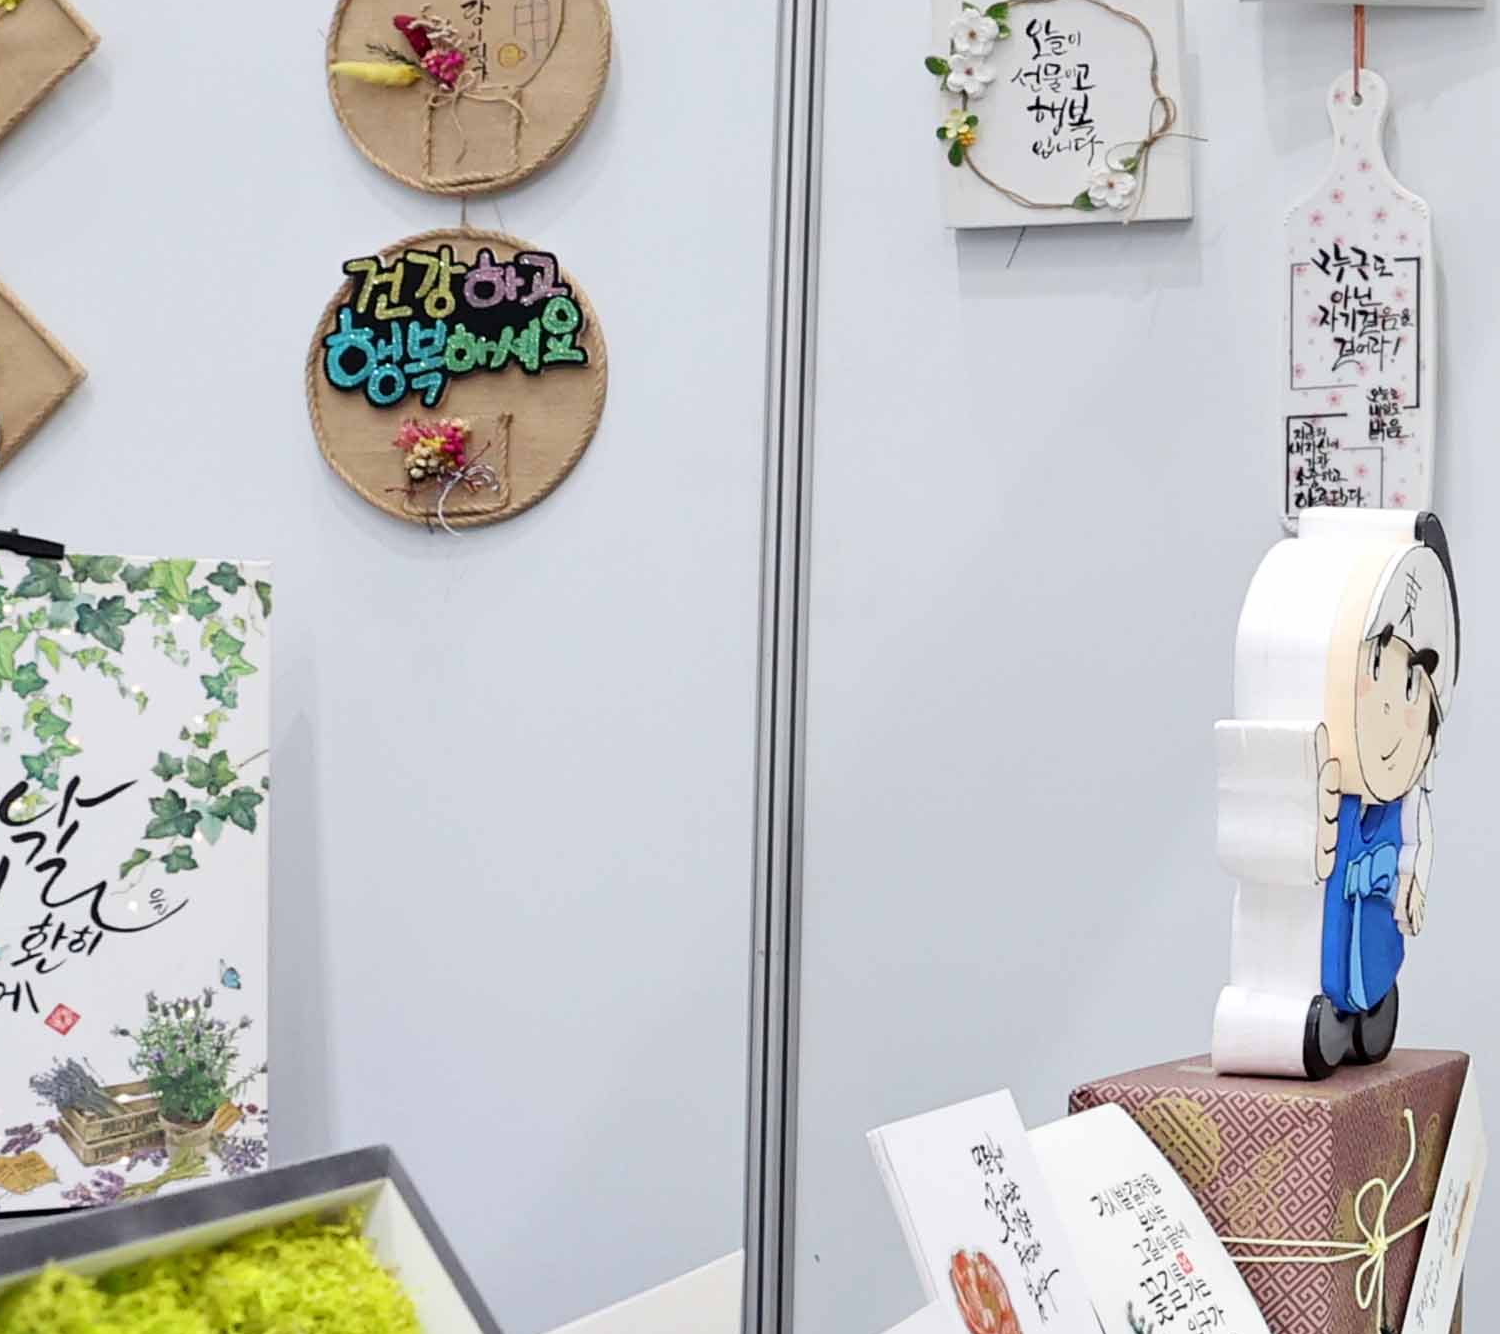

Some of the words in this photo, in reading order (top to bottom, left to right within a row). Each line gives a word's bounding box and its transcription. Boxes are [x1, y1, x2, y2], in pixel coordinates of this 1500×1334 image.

[1026, 18, 1081, 59] 오늘이
[1011, 62, 1097, 93] 선물이고
[1026, 93, 1094, 137] 행복
[1032, 135, 1104, 165] 입니다
[343, 244, 572, 322] 건강하고
[1330, 284, 1383, 310] 아닌
[323, 294, 589, 409] 행복하세요
[1331, 335, 1401, 372] 걸어라!
[10, 911, 105, 977] 환히
